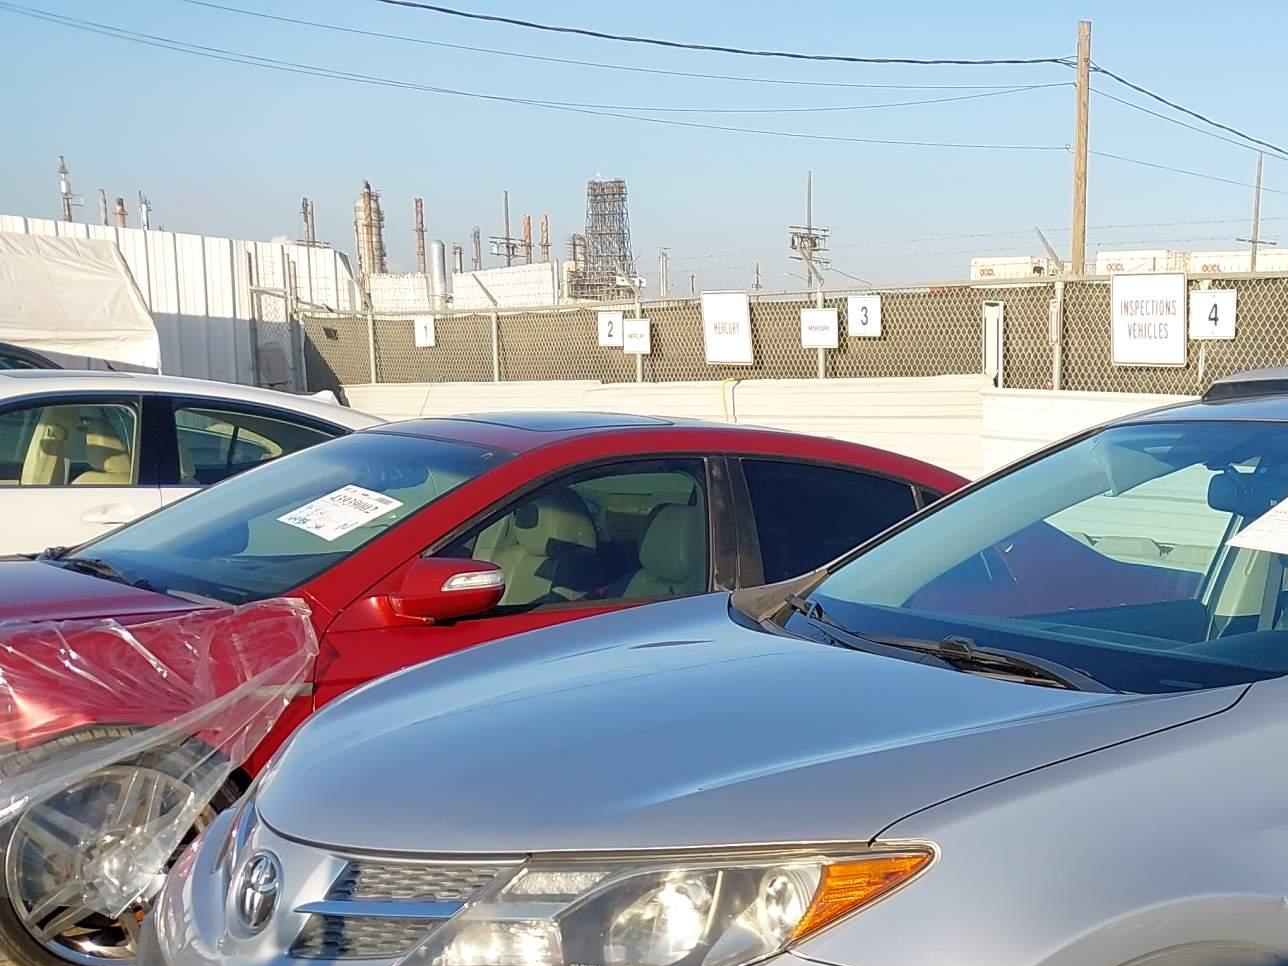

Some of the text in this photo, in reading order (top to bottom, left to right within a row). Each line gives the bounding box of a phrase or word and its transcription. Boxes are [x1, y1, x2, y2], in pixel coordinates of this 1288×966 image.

[860, 306, 869, 326] 3
[1120, 299, 1177, 317] INSPECTIONS
[1207, 303, 1220, 327] 4
[607, 320, 614, 338] 2
[713, 321, 740, 335] MERCURY
[1127, 322, 1169, 340] VEHICLES
